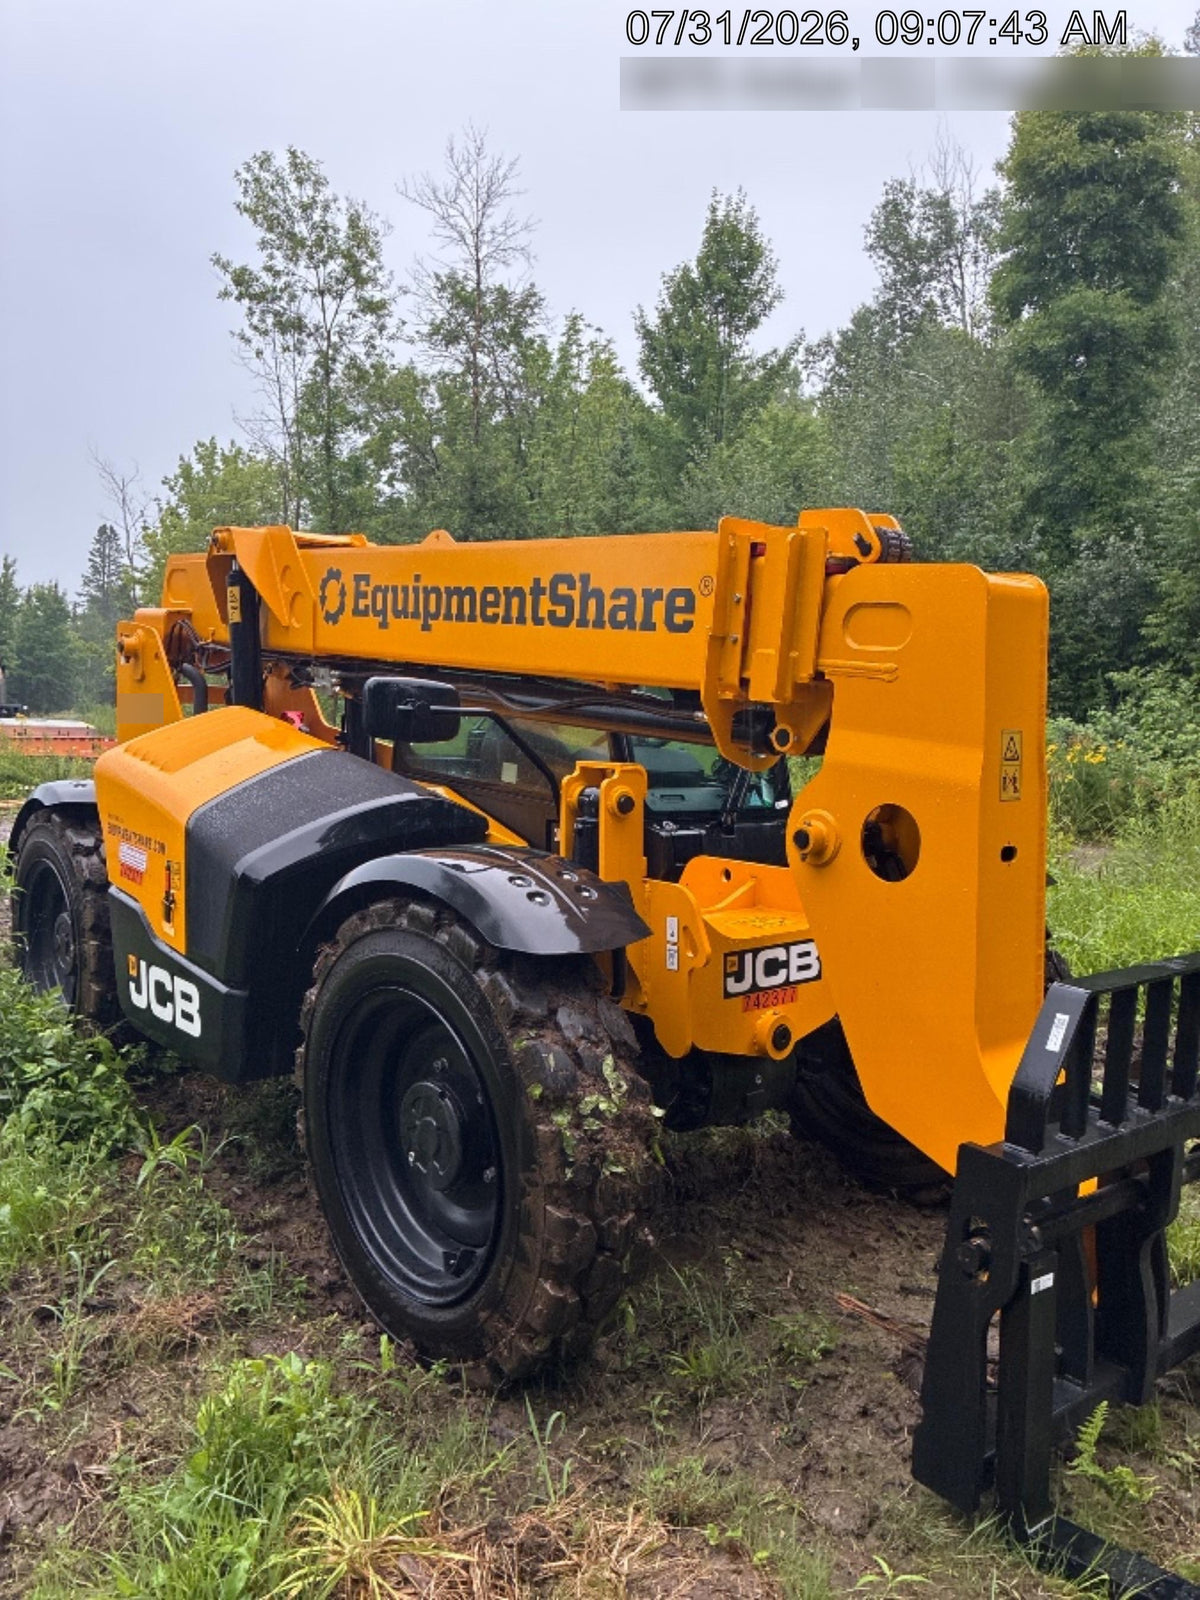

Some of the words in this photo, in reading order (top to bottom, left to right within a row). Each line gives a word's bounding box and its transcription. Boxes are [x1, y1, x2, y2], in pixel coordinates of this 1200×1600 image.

[352, 573, 697, 633] EquipmentShare
[127, 953, 202, 1038] JCB
[723, 941, 822, 995] JCB
